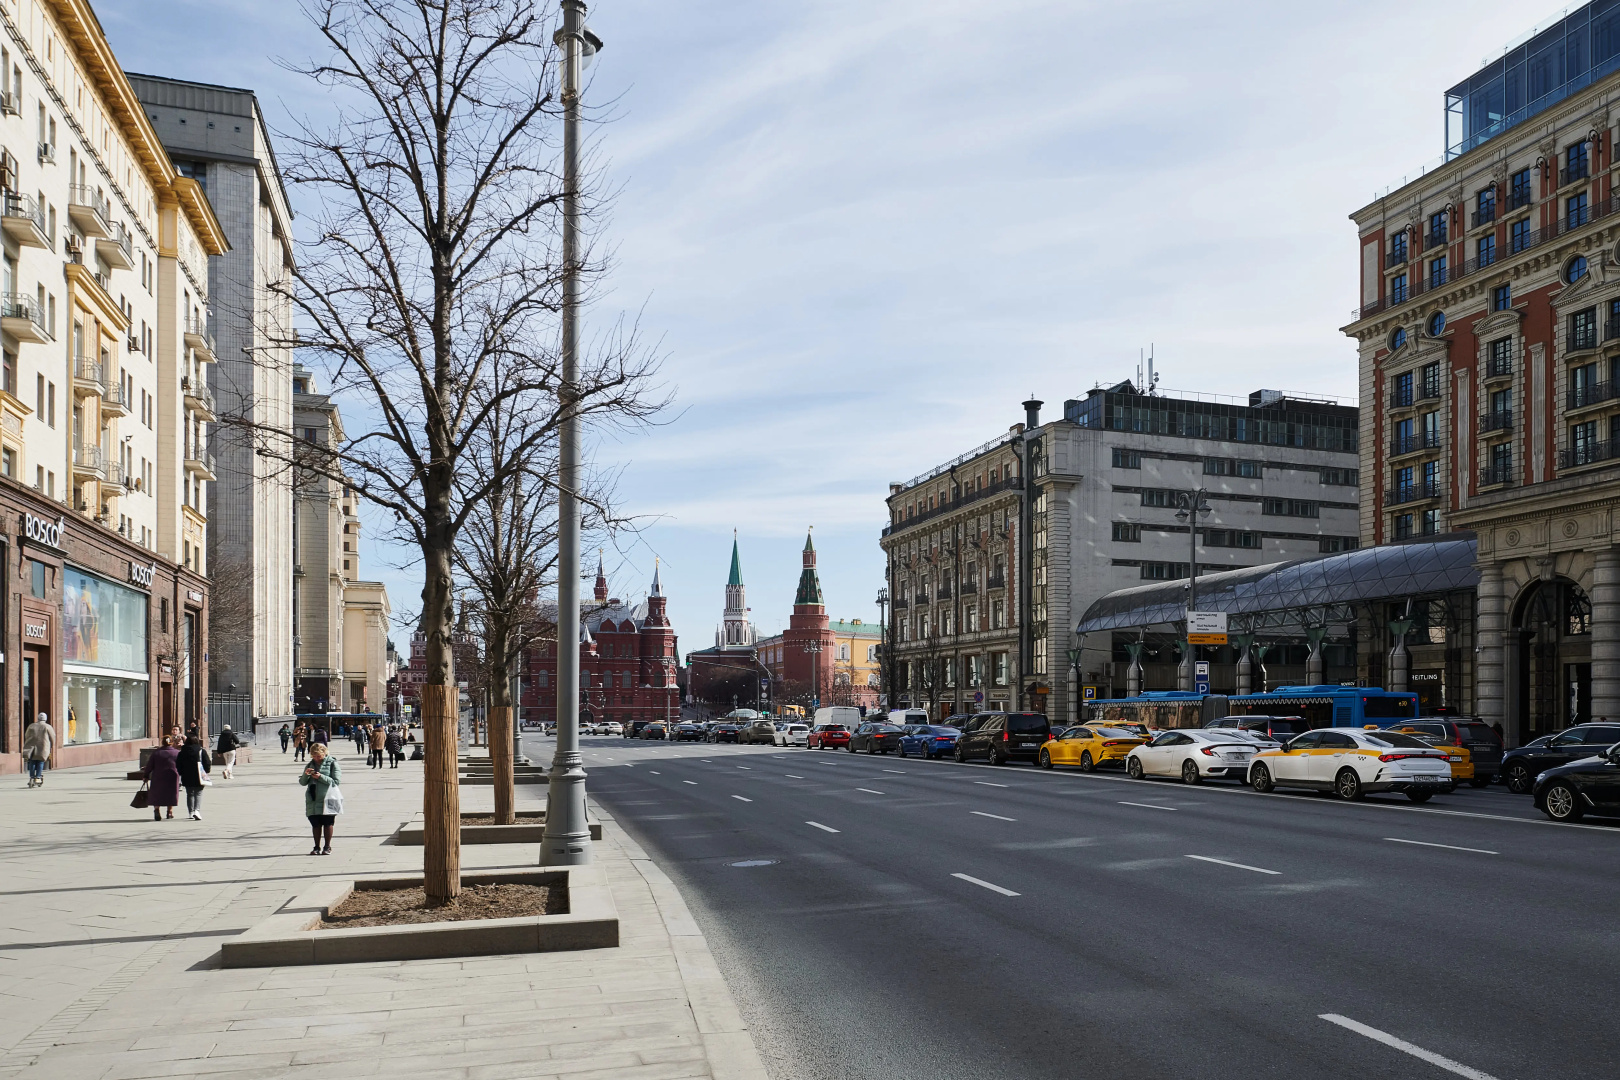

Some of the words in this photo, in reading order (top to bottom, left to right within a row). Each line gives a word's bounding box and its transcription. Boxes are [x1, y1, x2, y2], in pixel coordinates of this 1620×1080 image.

[26, 513, 59, 548] BOSCO
[132, 562, 153, 587] BOSCO
[26, 624, 44, 639] BOSCO
[1086, 689, 1093, 698] P
[1199, 684, 1207, 695] P
